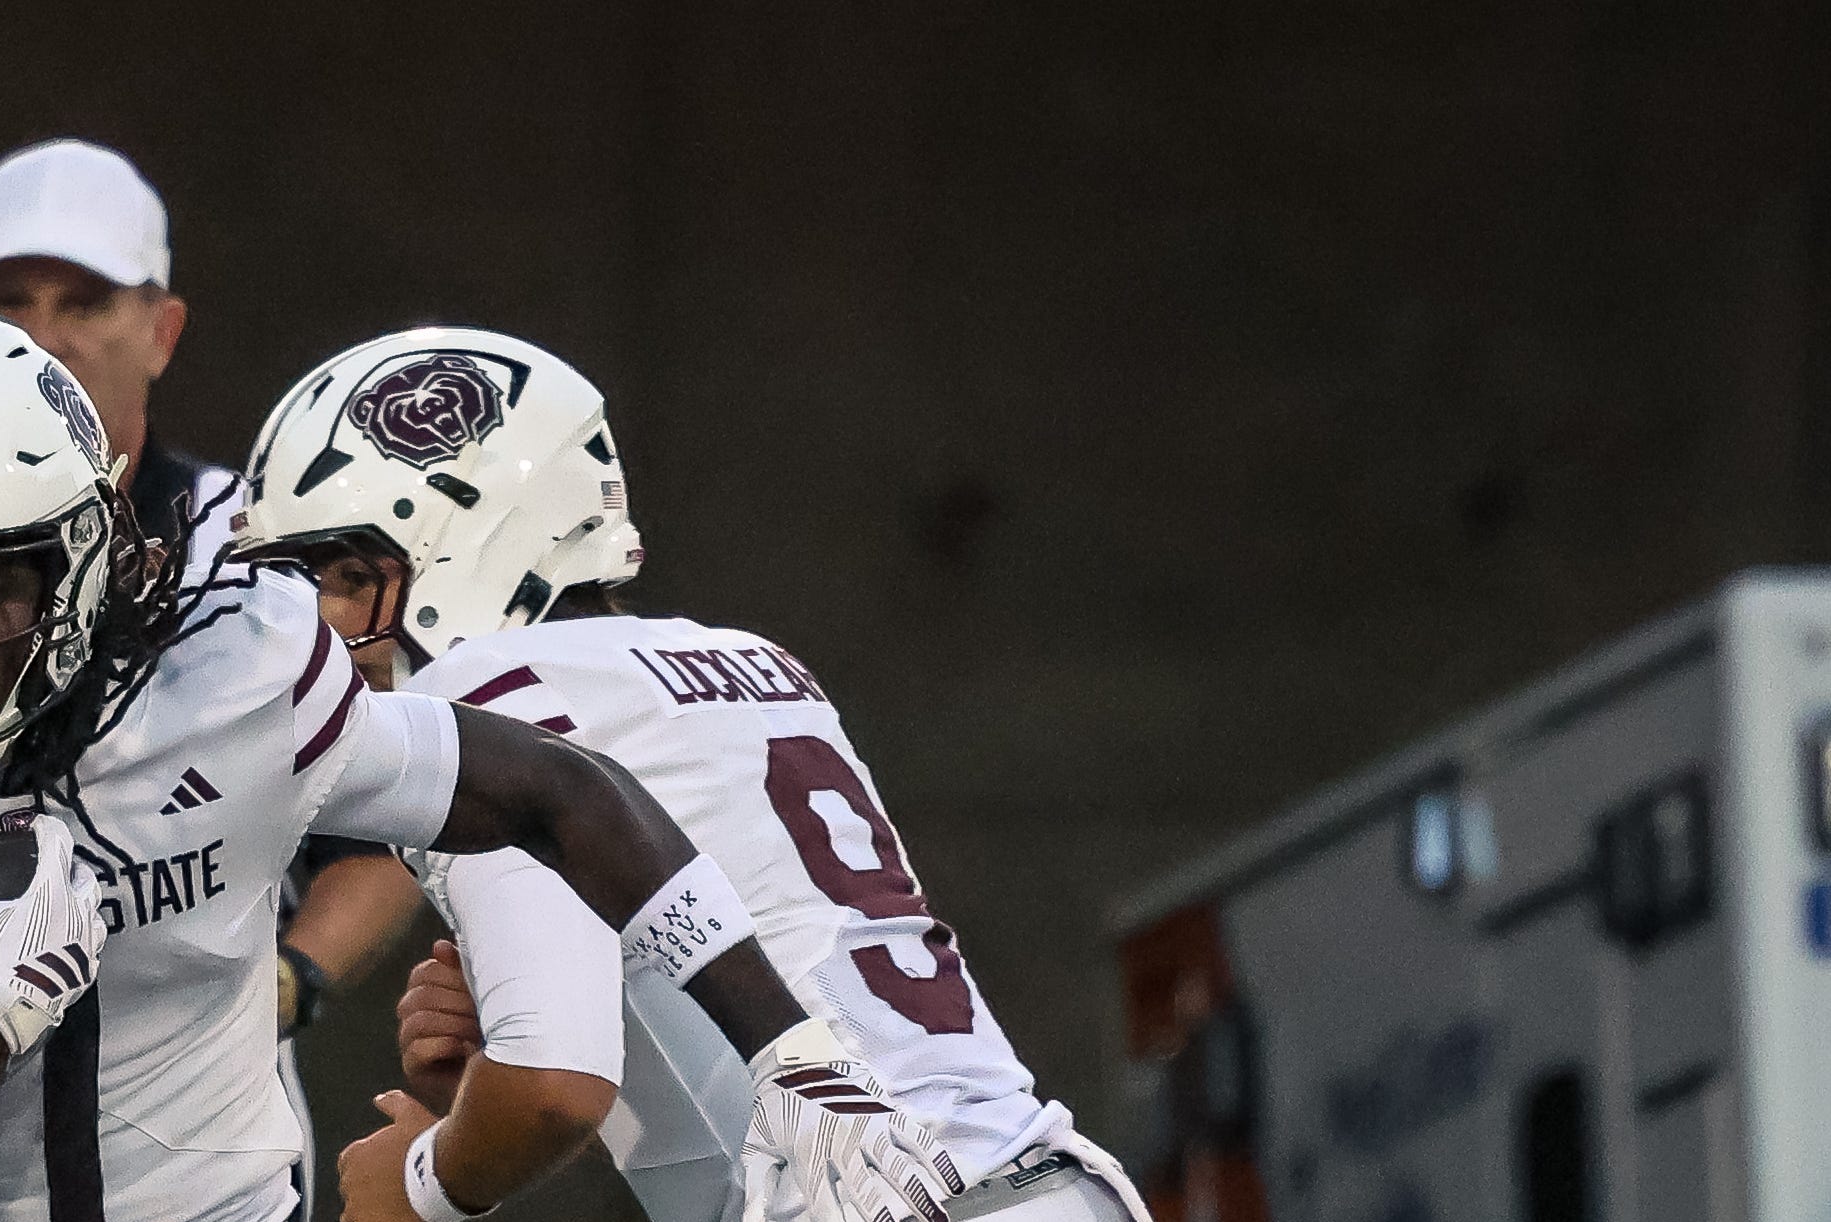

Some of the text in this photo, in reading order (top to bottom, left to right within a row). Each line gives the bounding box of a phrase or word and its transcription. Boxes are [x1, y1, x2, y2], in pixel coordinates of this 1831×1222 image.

[96, 838, 226, 935] STATE
[764, 735, 974, 1035] 9
[654, 915, 694, 957] YOU
[664, 918, 722, 977] JESUS
